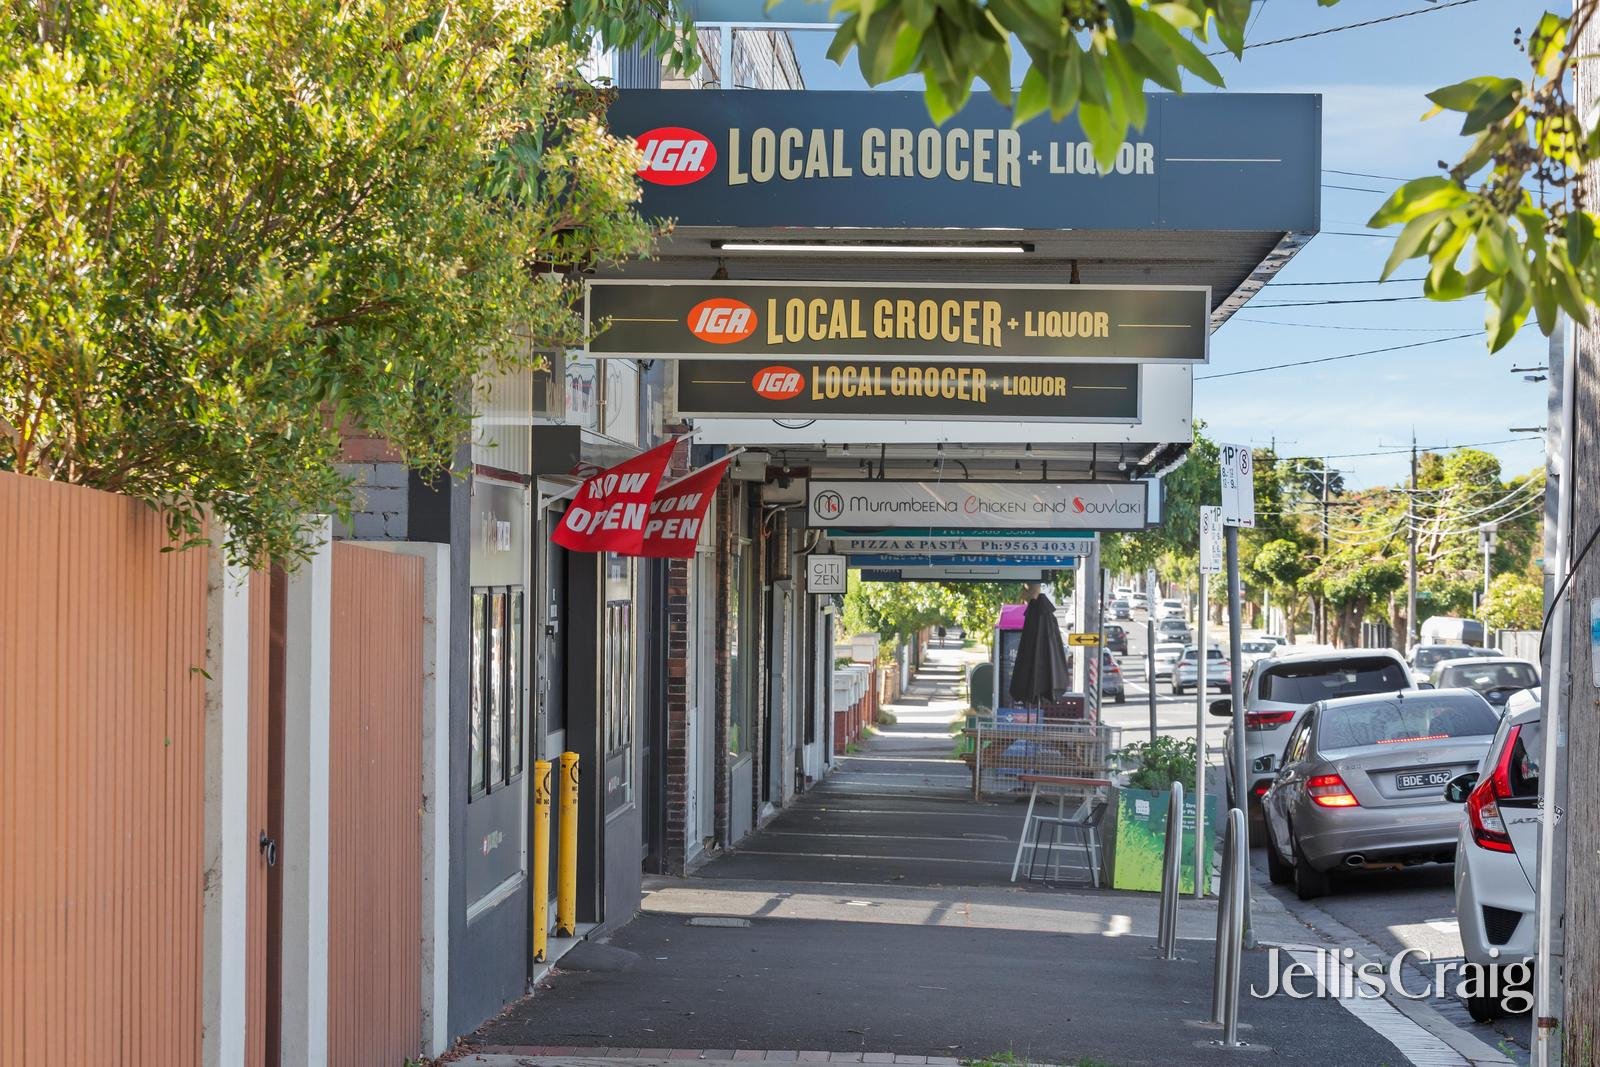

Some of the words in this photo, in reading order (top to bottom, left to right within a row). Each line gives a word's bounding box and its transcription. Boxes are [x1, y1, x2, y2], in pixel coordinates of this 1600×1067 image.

[637, 139, 708, 172] IGA
[728, 127, 852, 186] LOCAL
[861, 127, 1021, 188] GROCER
[1027, 149, 1042, 165] +
[694, 307, 751, 334] IGA
[767, 298, 867, 345] LOCAL
[873, 299, 1002, 347] GROCER
[1007, 317, 1019, 330] +
[1024, 311, 1109, 338] LIQUOR
[757, 372, 800, 392] IGA
[812, 365, 886, 400] LOCAL
[891, 366, 987, 403] GROCER
[990, 380, 999, 391] +
[1003, 375, 1066, 397] LIQUOR
[1222, 446, 1235, 466] 1P
[588, 472, 650, 499] NOW
[566, 502, 648, 535] OPEN
[643, 518, 700, 540] PEN
[851, 540, 899, 549] PIZZA
[904, 540, 915, 549] &
[920, 540, 968, 549] PASTA
[813, 563, 839, 575] CITI
[814, 575, 839, 586] ZEN
